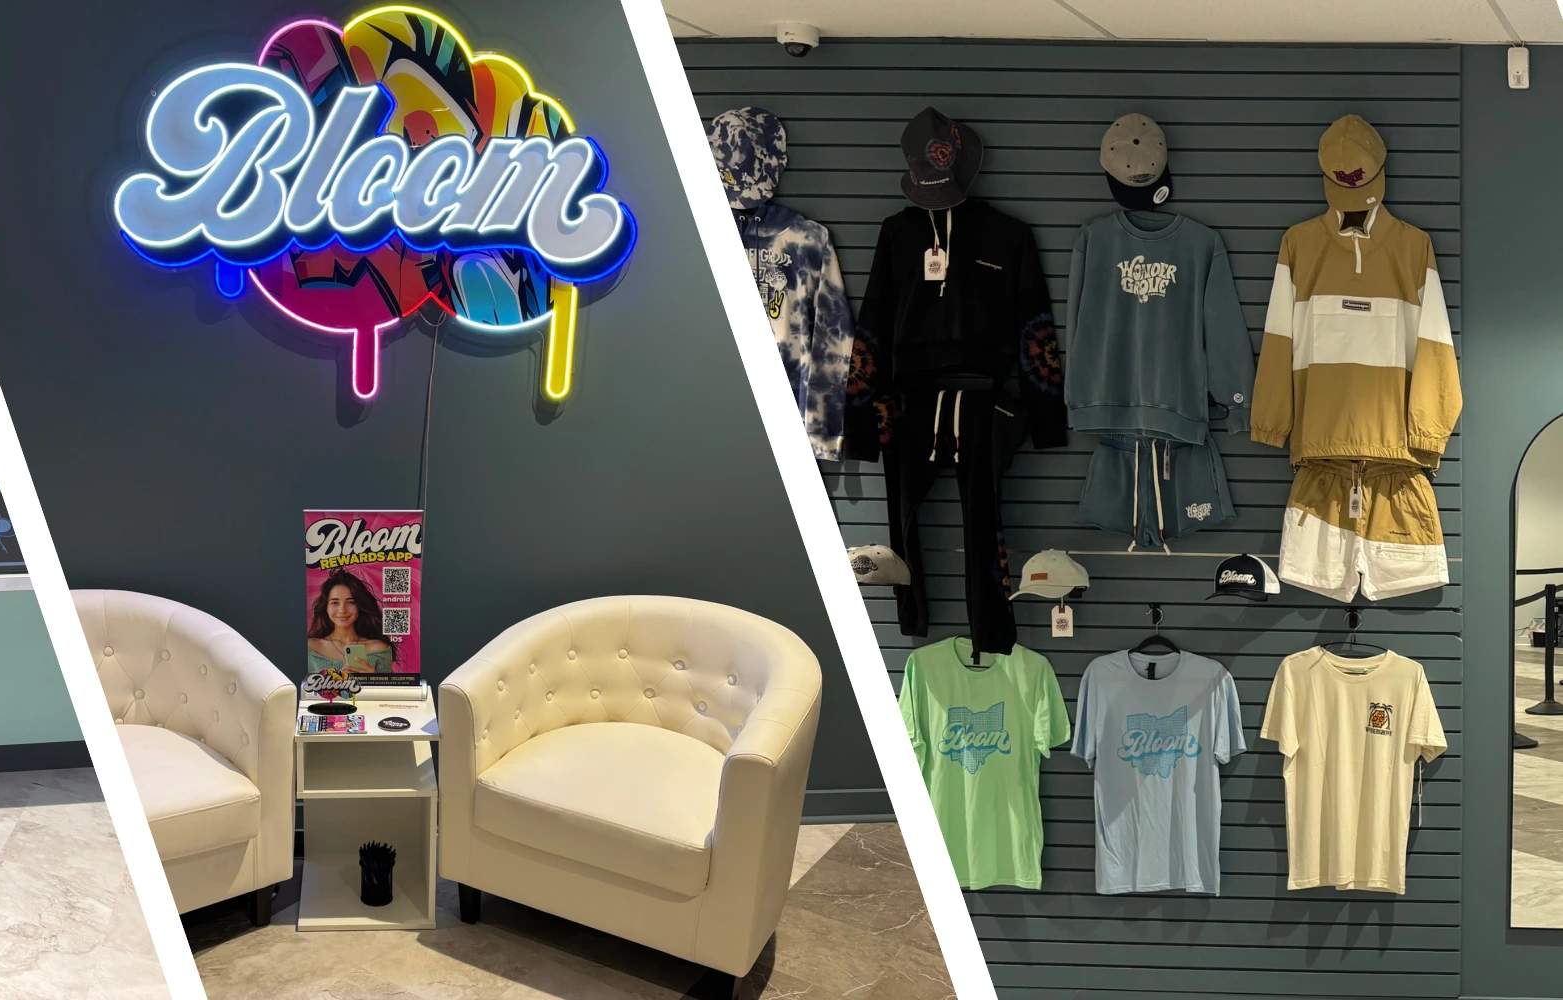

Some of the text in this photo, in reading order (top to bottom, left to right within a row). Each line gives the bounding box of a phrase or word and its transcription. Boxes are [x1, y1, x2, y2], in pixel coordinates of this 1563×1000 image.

[114, 61, 628, 268] Bloom
[305, 518, 422, 564] Bloom
[319, 551, 413, 570] REWARDS APP
[1219, 569, 1256, 585] Bloom
[382, 595, 411, 603] android
[304, 673, 361, 693] Bloom
[1118, 728, 1202, 761] Bloom
